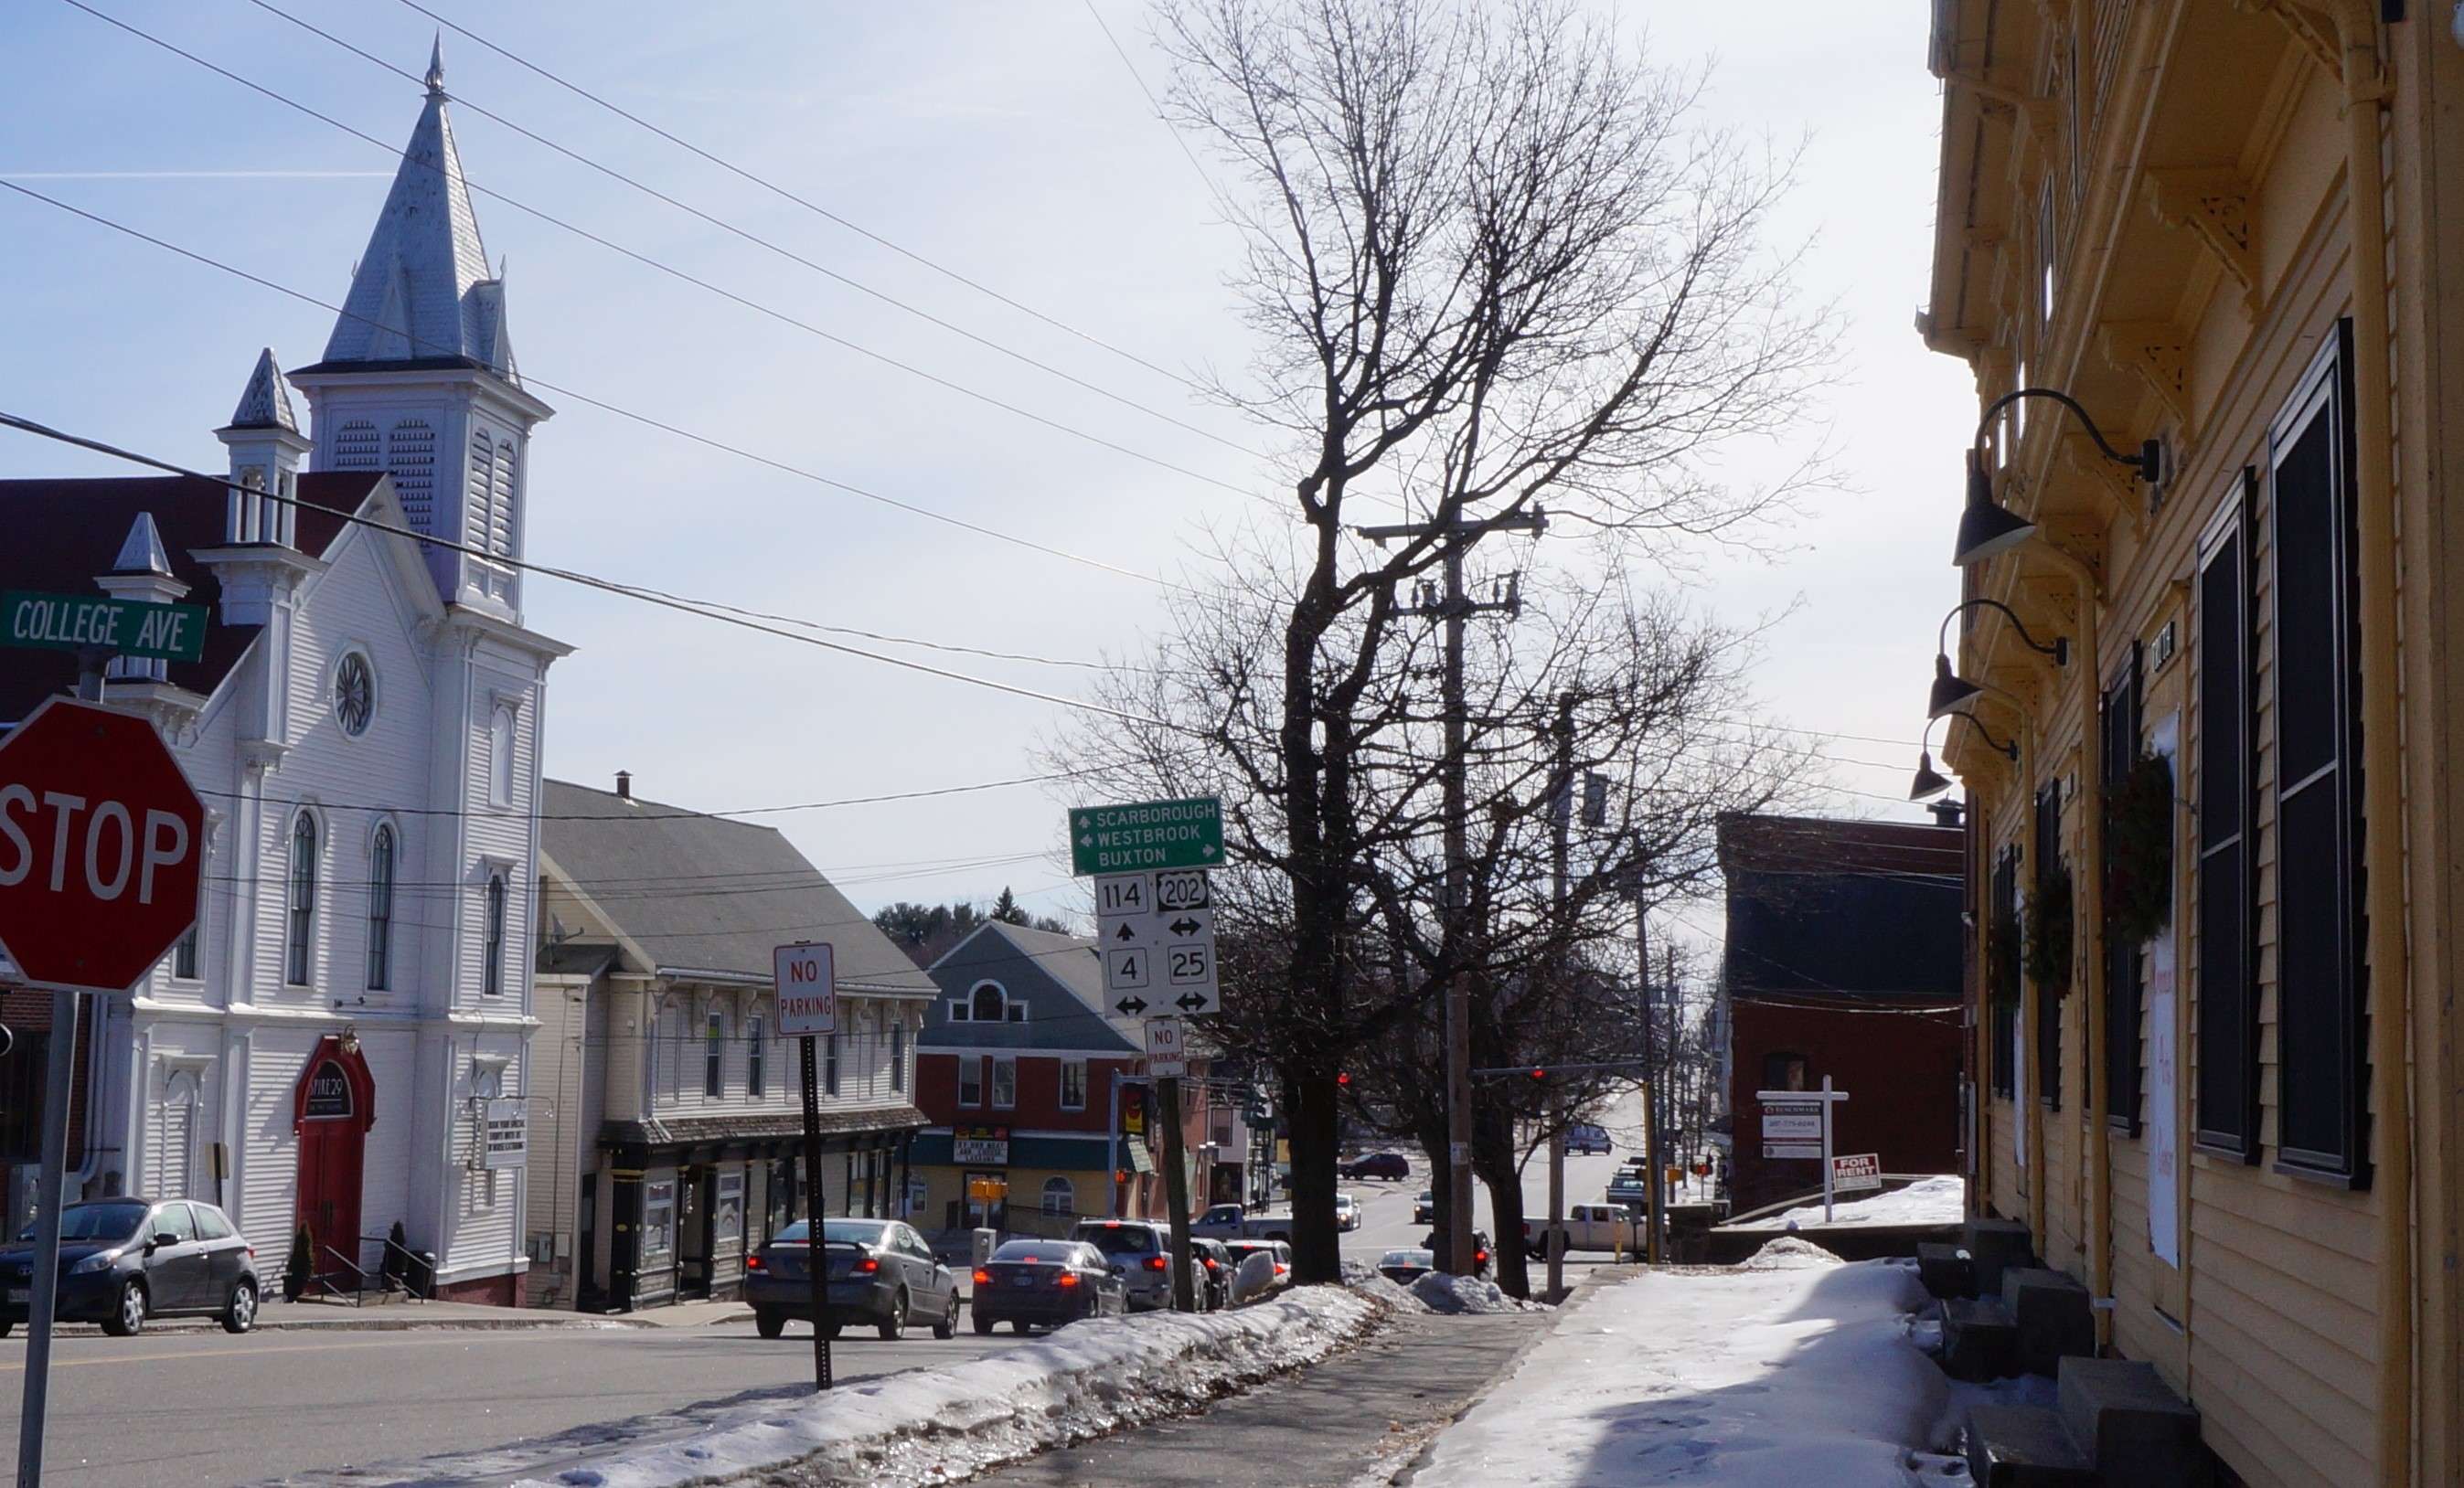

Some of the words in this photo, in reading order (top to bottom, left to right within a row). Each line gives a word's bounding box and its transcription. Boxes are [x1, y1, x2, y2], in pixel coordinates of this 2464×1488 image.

[13, 600, 124, 645] COLLEGE
[135, 610, 189, 652] AVE
[1097, 803, 1216, 827] SCARBOROUGH
[0, 782, 189, 905] STOP
[1097, 824, 1201, 847] WESTBROOK
[1099, 847, 1166, 866] BUXTON
[1104, 882, 1141, 909] 114
[1165, 878, 1200, 904] 202
[790, 960, 817, 983] NO
[1120, 956, 1137, 980] 4
[1172, 951, 1205, 977] 25
[780, 996, 831, 1018] PARKING
[1155, 1029, 1173, 1045] NO
[1148, 1052, 1182, 1063] PARKING
[1837, 1165, 1875, 1177] RENT
[1840, 1157, 1870, 1168] FOR
